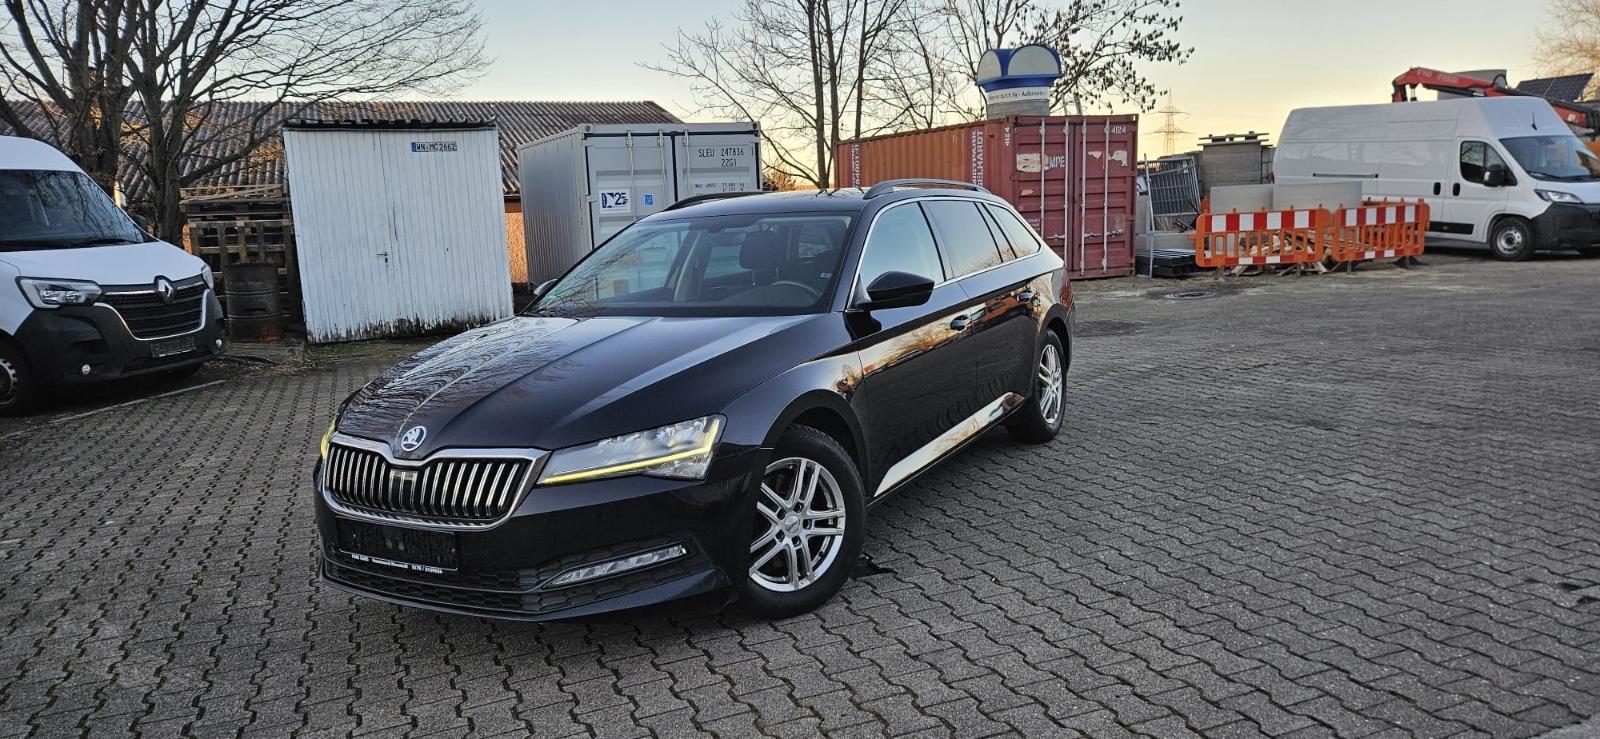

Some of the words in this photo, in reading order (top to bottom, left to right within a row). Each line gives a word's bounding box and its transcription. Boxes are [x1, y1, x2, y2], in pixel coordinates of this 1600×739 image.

[1111, 125, 1127, 134] 4124
[698, 148, 715, 158] SLEU
[720, 147, 745, 157] 247836
